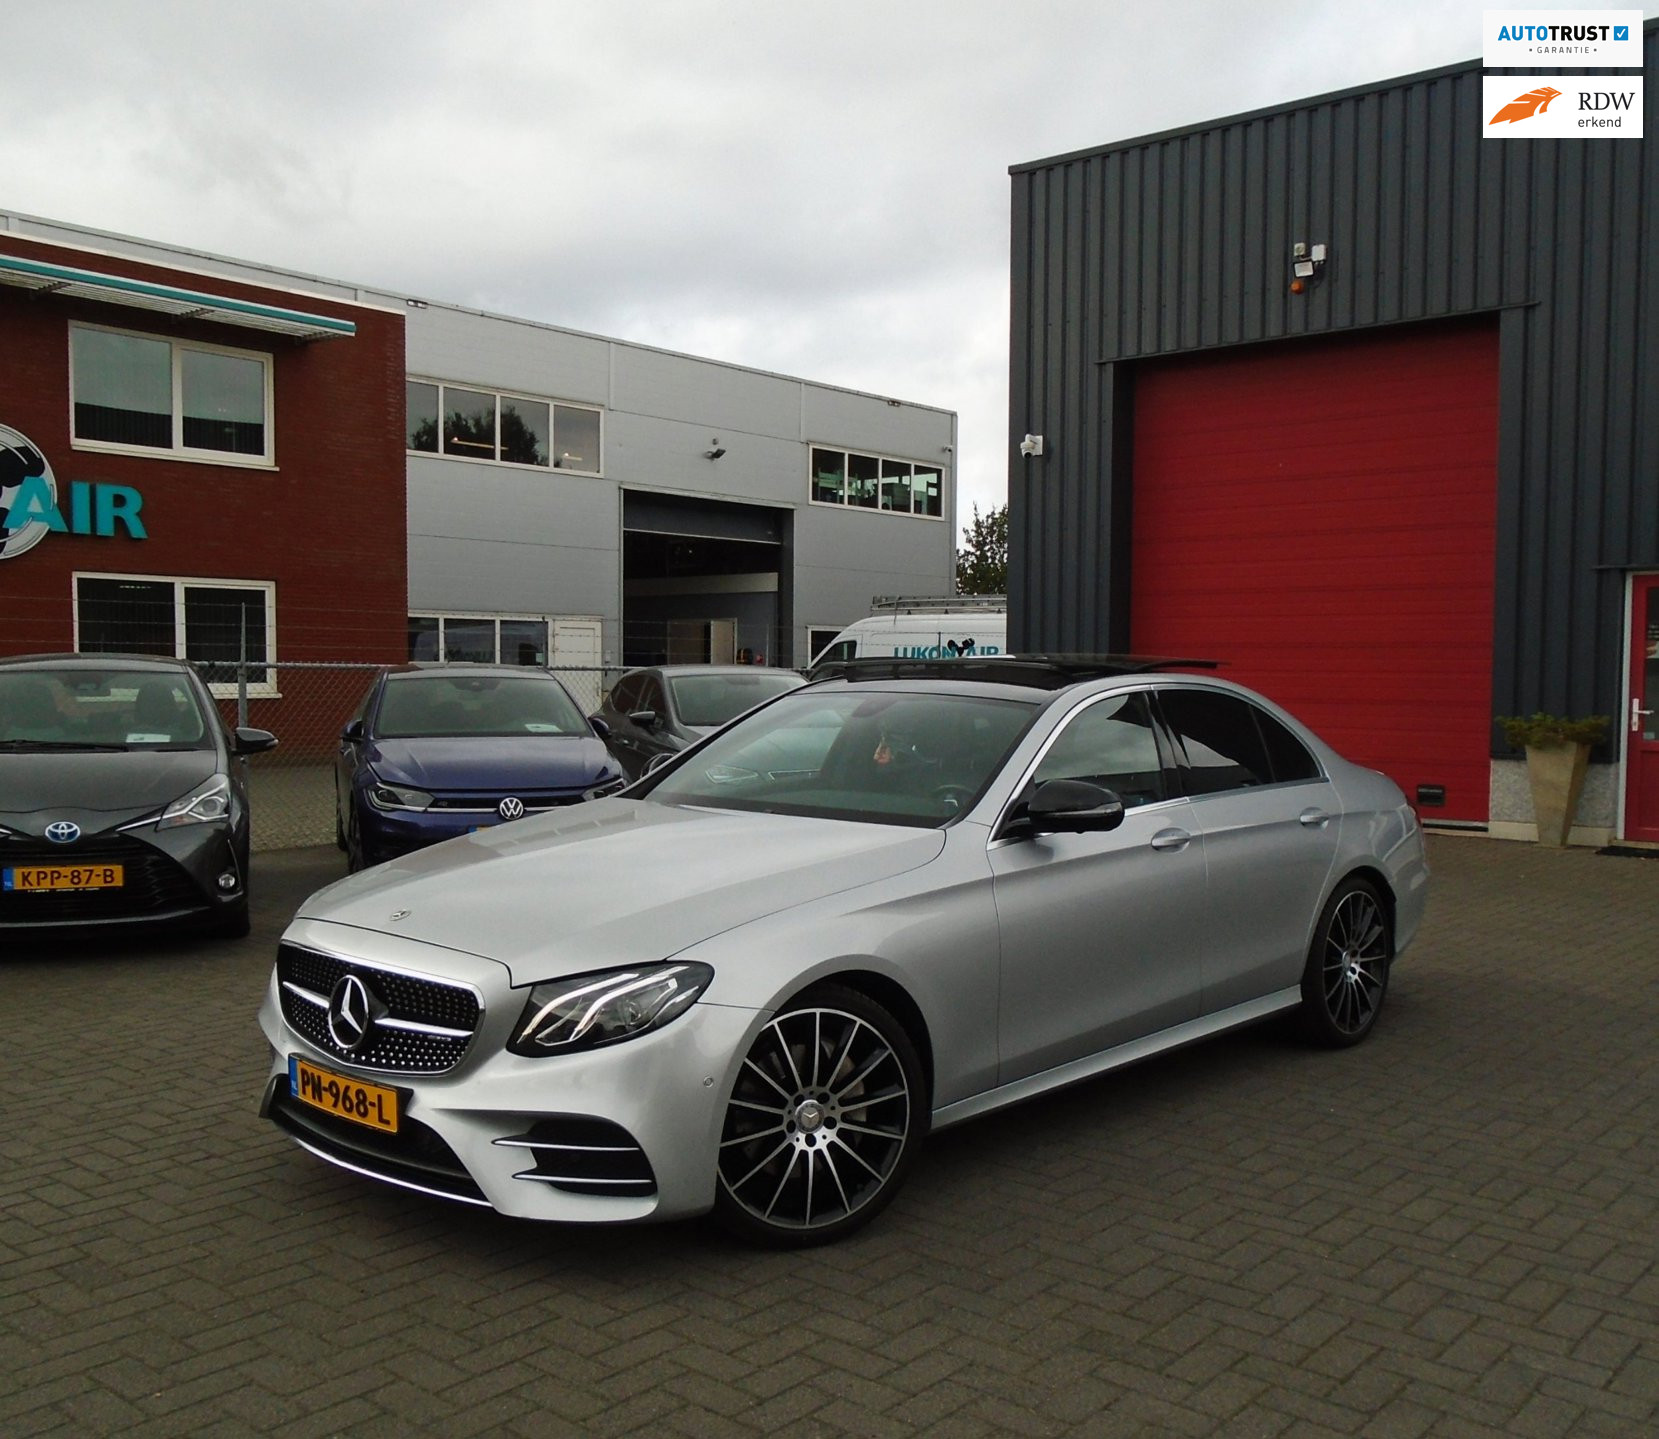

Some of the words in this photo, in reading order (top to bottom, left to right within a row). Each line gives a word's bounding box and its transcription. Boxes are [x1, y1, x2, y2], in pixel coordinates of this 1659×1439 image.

[2, 476, 148, 539] AIR
[894, 645, 957, 660] LUKON
[21, 868, 115, 887] KPP-87-B
[300, 1067, 391, 1125] PN-968-L
